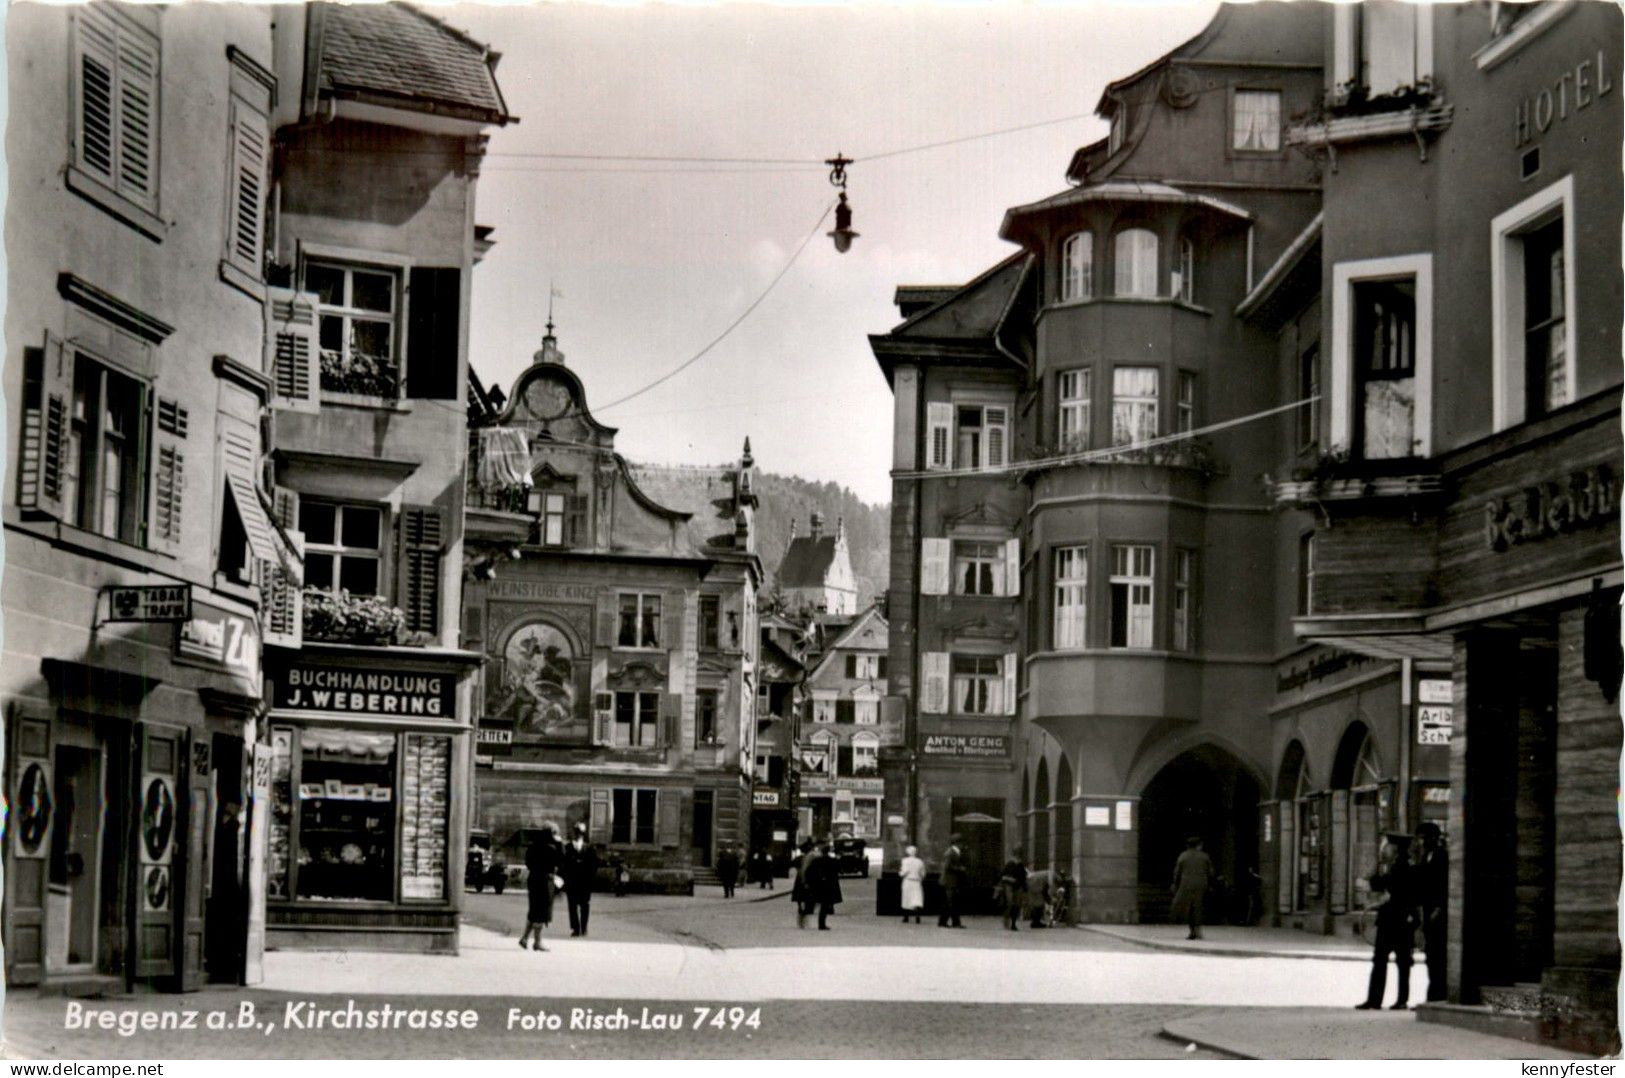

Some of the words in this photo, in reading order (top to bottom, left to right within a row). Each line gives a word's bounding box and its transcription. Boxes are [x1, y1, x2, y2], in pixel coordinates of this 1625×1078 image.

[1515, 51, 1612, 149] HOTEL
[143, 588, 184, 602] TABAK
[143, 604, 185, 617] TRAFIK
[289, 669, 441, 694] BUCHHANDLUNG
[287, 689, 308, 707] J.
[312, 690, 441, 714] WEBERING
[926, 735, 966, 746] ANTON
